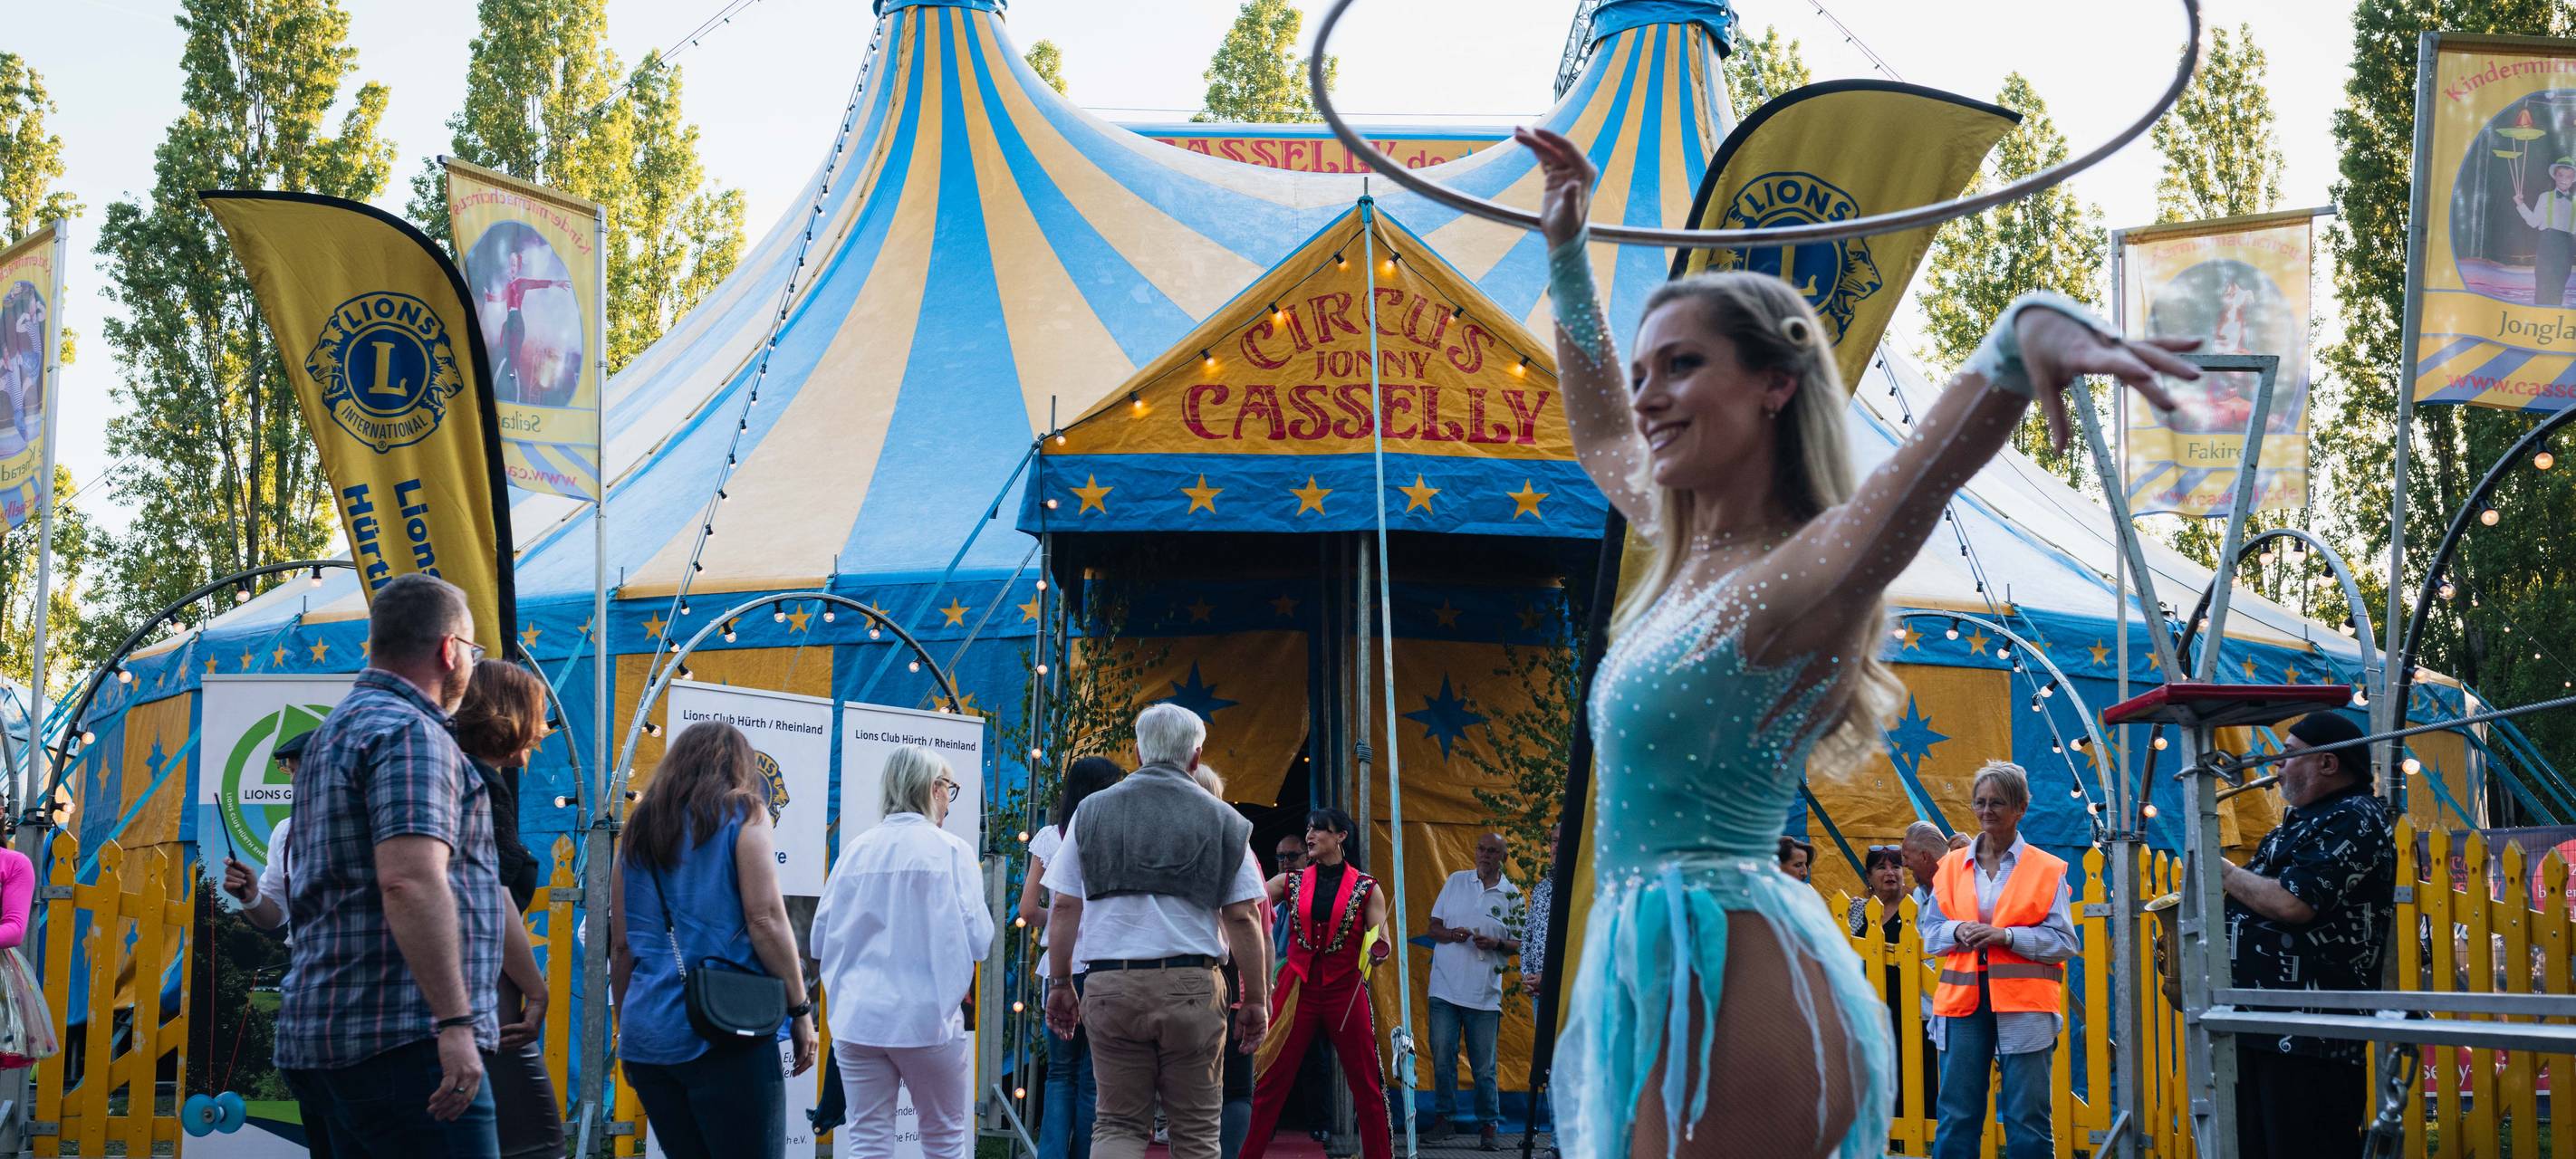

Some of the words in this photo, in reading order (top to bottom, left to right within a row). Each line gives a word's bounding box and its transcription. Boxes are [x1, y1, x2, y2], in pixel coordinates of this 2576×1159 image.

[1745, 180, 1851, 225] LIONS
[343, 298, 436, 335] LIONS
[1240, 287, 1495, 374] CIRCUS
[368, 341, 408, 397] L
[1314, 350, 1432, 380] JONNY
[341, 406, 428, 439] INTERNATIONAL
[1182, 383, 1551, 445] CASSELLY
[683, 709, 710, 721] Lions
[737, 715, 766, 728] Hürth
[769, 720, 774, 729] /
[775, 721, 823, 734] Rheinland
[855, 729, 879, 741] Lions
[880, 732, 899, 742] Club
[902, 734, 927, 746] Hürth
[928, 738, 933, 746] /
[935, 738, 976, 751] Rheinland
[245, 790, 281, 800] LIONS
